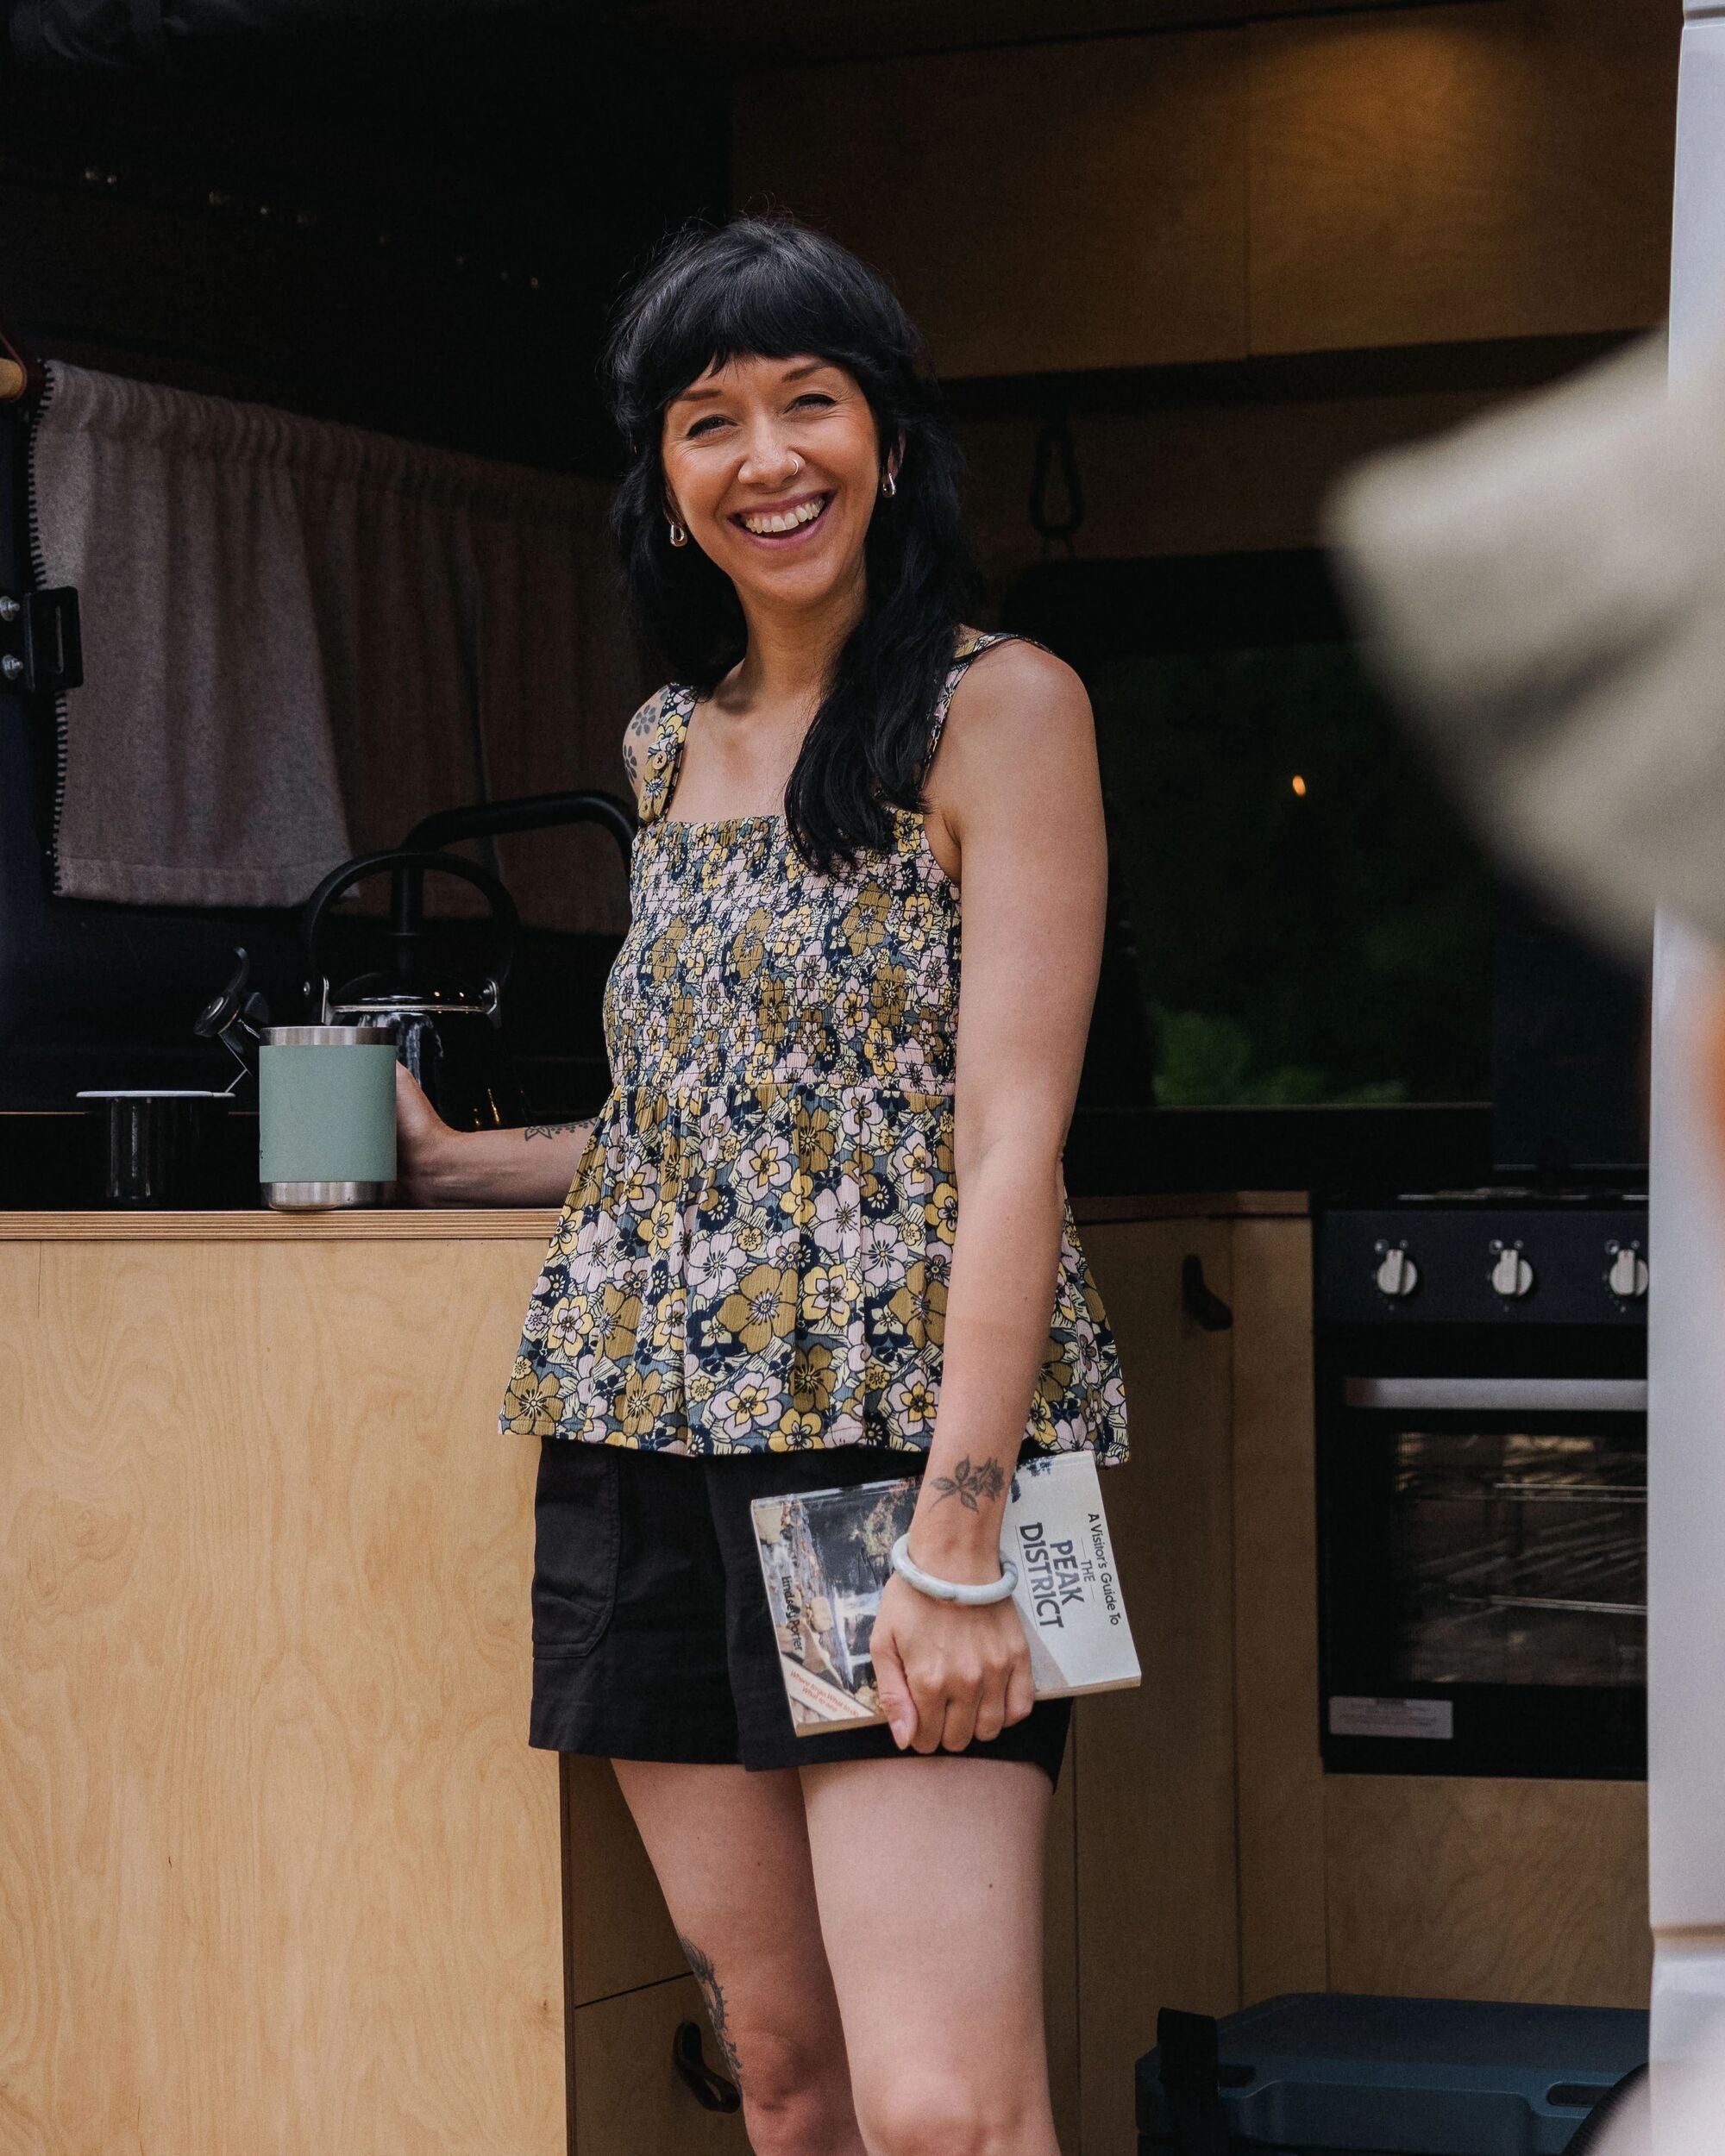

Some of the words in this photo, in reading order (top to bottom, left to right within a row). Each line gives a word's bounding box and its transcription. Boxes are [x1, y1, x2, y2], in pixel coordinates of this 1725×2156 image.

[1088, 1513, 1100, 1523] A
[1090, 1524, 1108, 1569] Visitor's
[1019, 1522, 1064, 1628] DISTRICT
[1050, 1539, 1085, 1606] PEAK
[1081, 1559, 1096, 1583] THE
[1101, 1572, 1117, 1611] Guide
[781, 1575, 797, 1619] Lindsey
[790, 1619, 803, 1651] Porter
[1109, 1613, 1121, 1626] To
